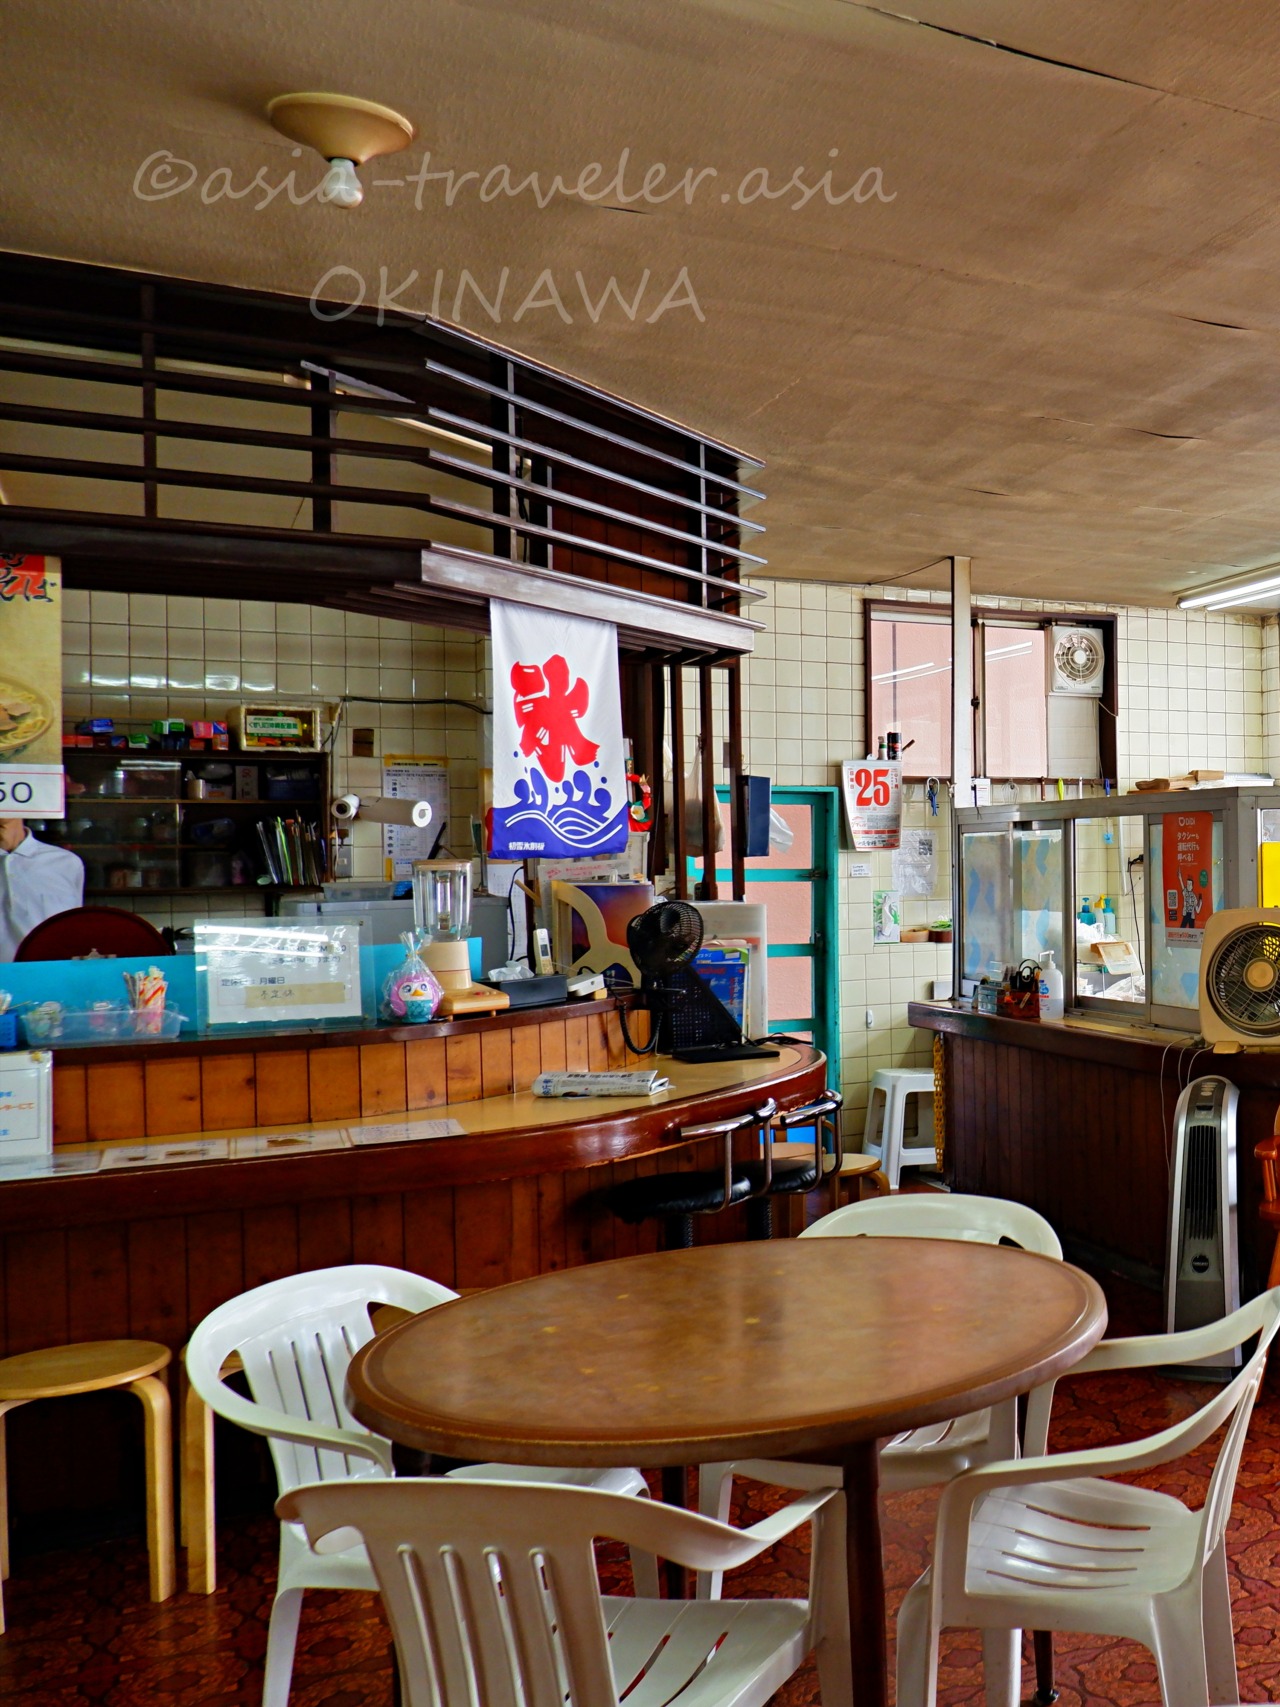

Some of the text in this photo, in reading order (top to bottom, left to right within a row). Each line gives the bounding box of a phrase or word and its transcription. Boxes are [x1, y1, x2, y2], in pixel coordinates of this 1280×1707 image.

[510, 654, 600, 783] 氷
[854, 768, 890, 807] 25
[1177, 832, 1199, 840] タクシーも
